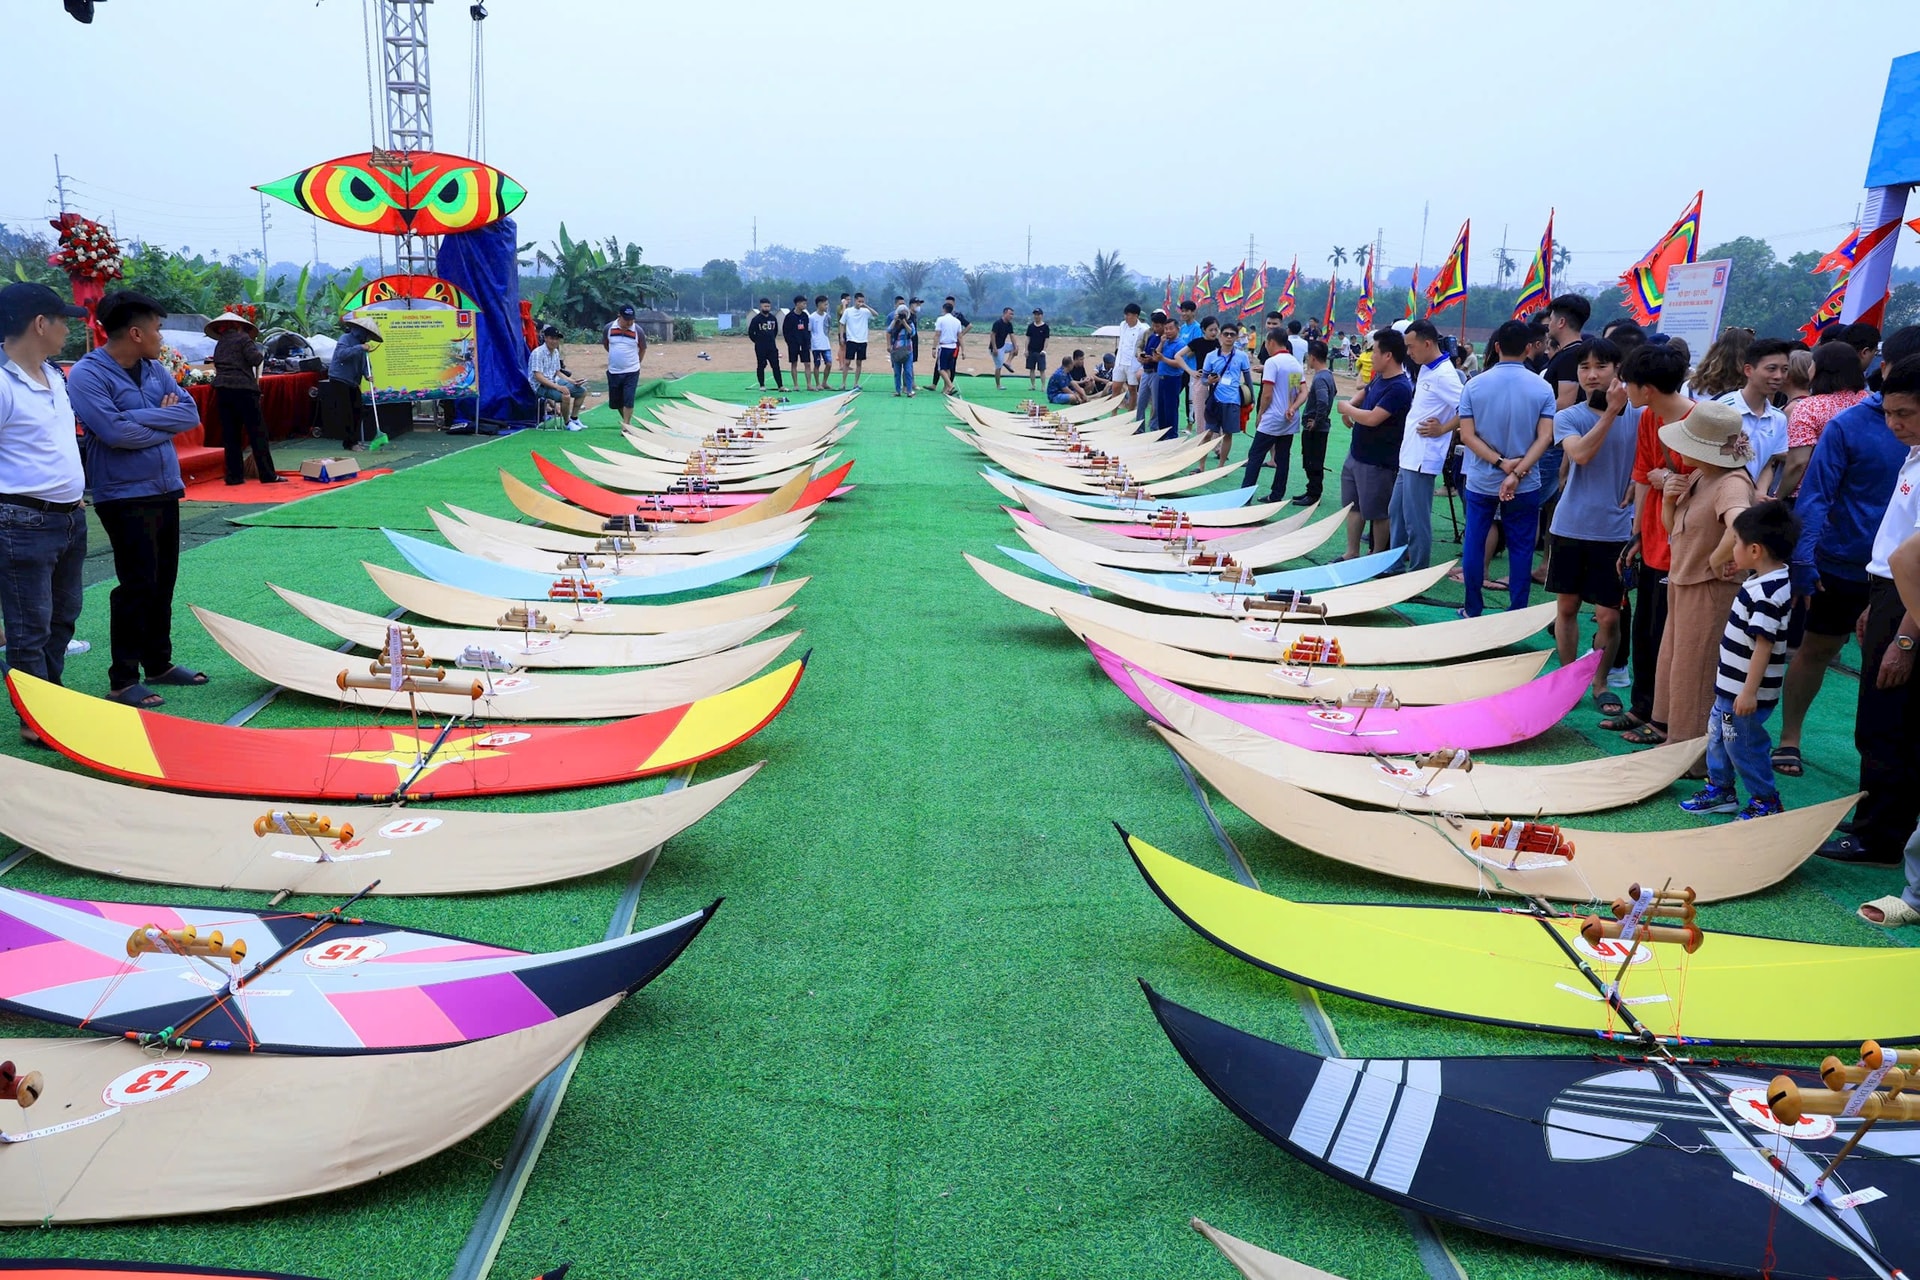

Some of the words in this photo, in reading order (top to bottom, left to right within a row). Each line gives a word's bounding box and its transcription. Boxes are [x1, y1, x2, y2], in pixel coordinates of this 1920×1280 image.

[390, 821, 428, 833] 17
[318, 944, 368, 961] 15
[124, 1069, 189, 1094] 13
